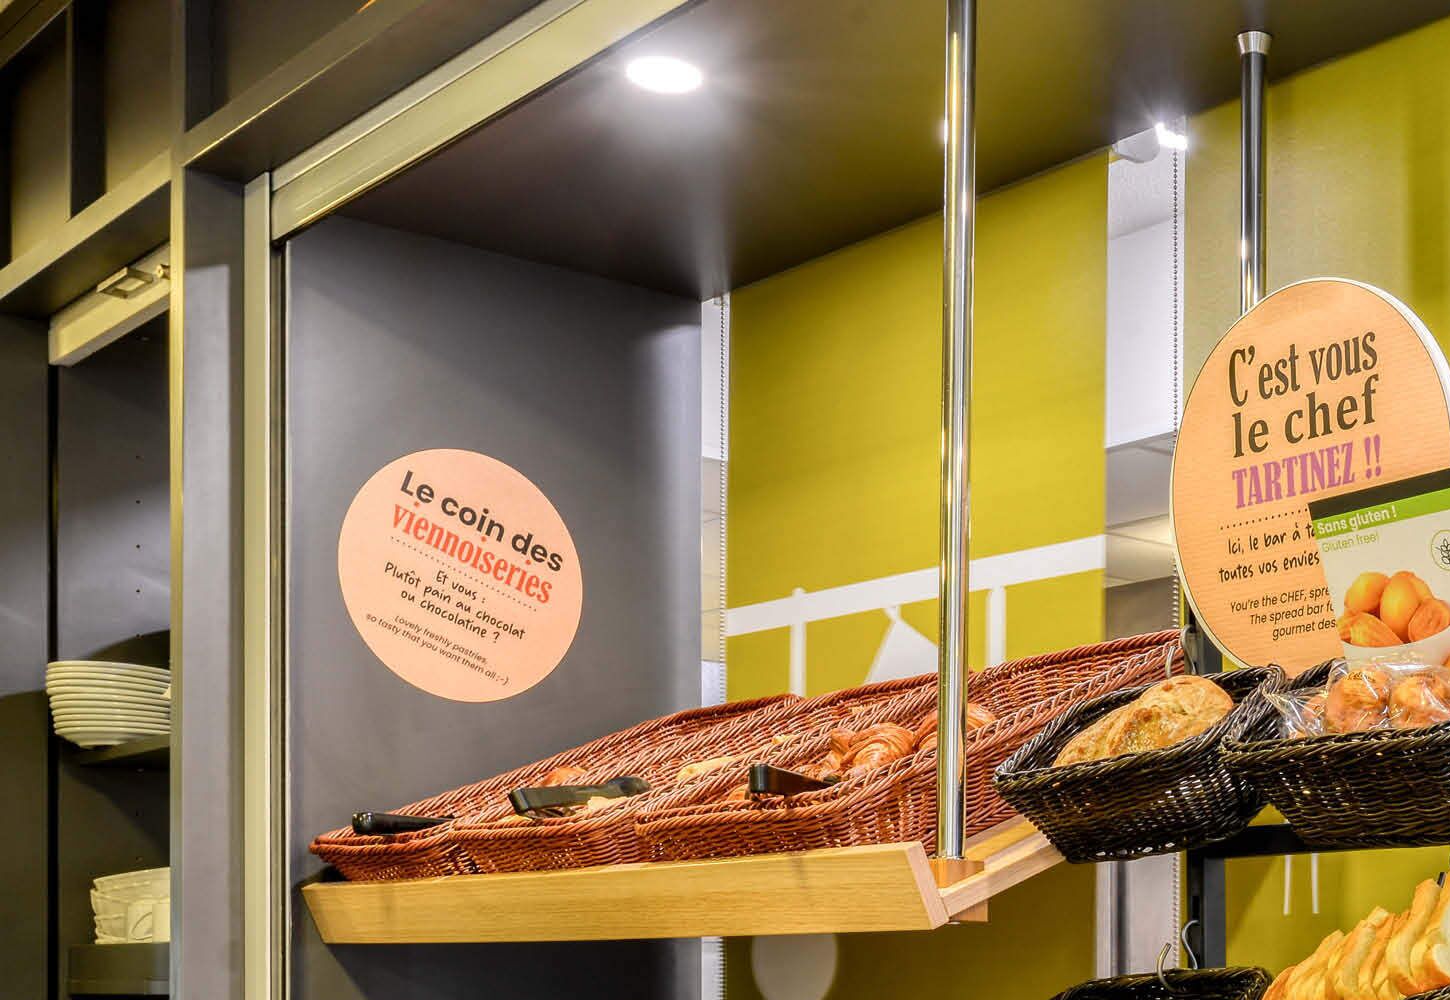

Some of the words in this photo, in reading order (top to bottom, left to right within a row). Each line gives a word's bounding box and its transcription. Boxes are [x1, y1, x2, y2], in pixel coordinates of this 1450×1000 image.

[1308, 331, 1378, 385] vous
[1231, 412, 1269, 458] le
[1284, 373, 1379, 446] chef
[1232, 441, 1357, 509] TARTINEZ
[1364, 434, 1383, 480] !!
[400, 470, 435, 503] Le
[440, 497, 505, 543] coin
[511, 532, 564, 572] des
[1317, 518, 1347, 534] Sans
[1349, 507, 1390, 529] gluten
[392, 501, 553, 604] viennoiseries
[1228, 538, 1245, 555] Ici,
[1250, 535, 1259, 551] le
[1264, 532, 1287, 547] bar
[1292, 523, 1301, 540] à
[1321, 536, 1353, 552] Gluten
[1219, 565, 1254, 583] toutes
[1258, 559, 1278, 575] vos
[1283, 550, 1320, 571] envies
[384, 562, 422, 588] Plutôt
[423, 584, 452, 604] pain
[456, 600, 472, 613] au
[475, 609, 526, 640] chocolat
[436, 570, 448, 585] Et
[451, 581, 478, 601] vous
[1262, 594, 1278, 607] the
[1280, 589, 1308, 605] CHEF,
[394, 615, 423, 635] Lovely
[400, 589, 415, 603] ou
[420, 598, 487, 638] chocolatine
[492, 631, 501, 643] ?
[1250, 614, 1267, 625] The
[1269, 605, 1304, 625] spread
[1306, 602, 1324, 616] bar
[366, 613, 377, 623] so
[378, 618, 401, 635] tasty
[401, 630, 421, 643] that
[421, 638, 438, 652] you
[439, 646, 461, 663] want
[462, 656, 485, 675] them
[1272, 620, 1316, 641] gourmet
